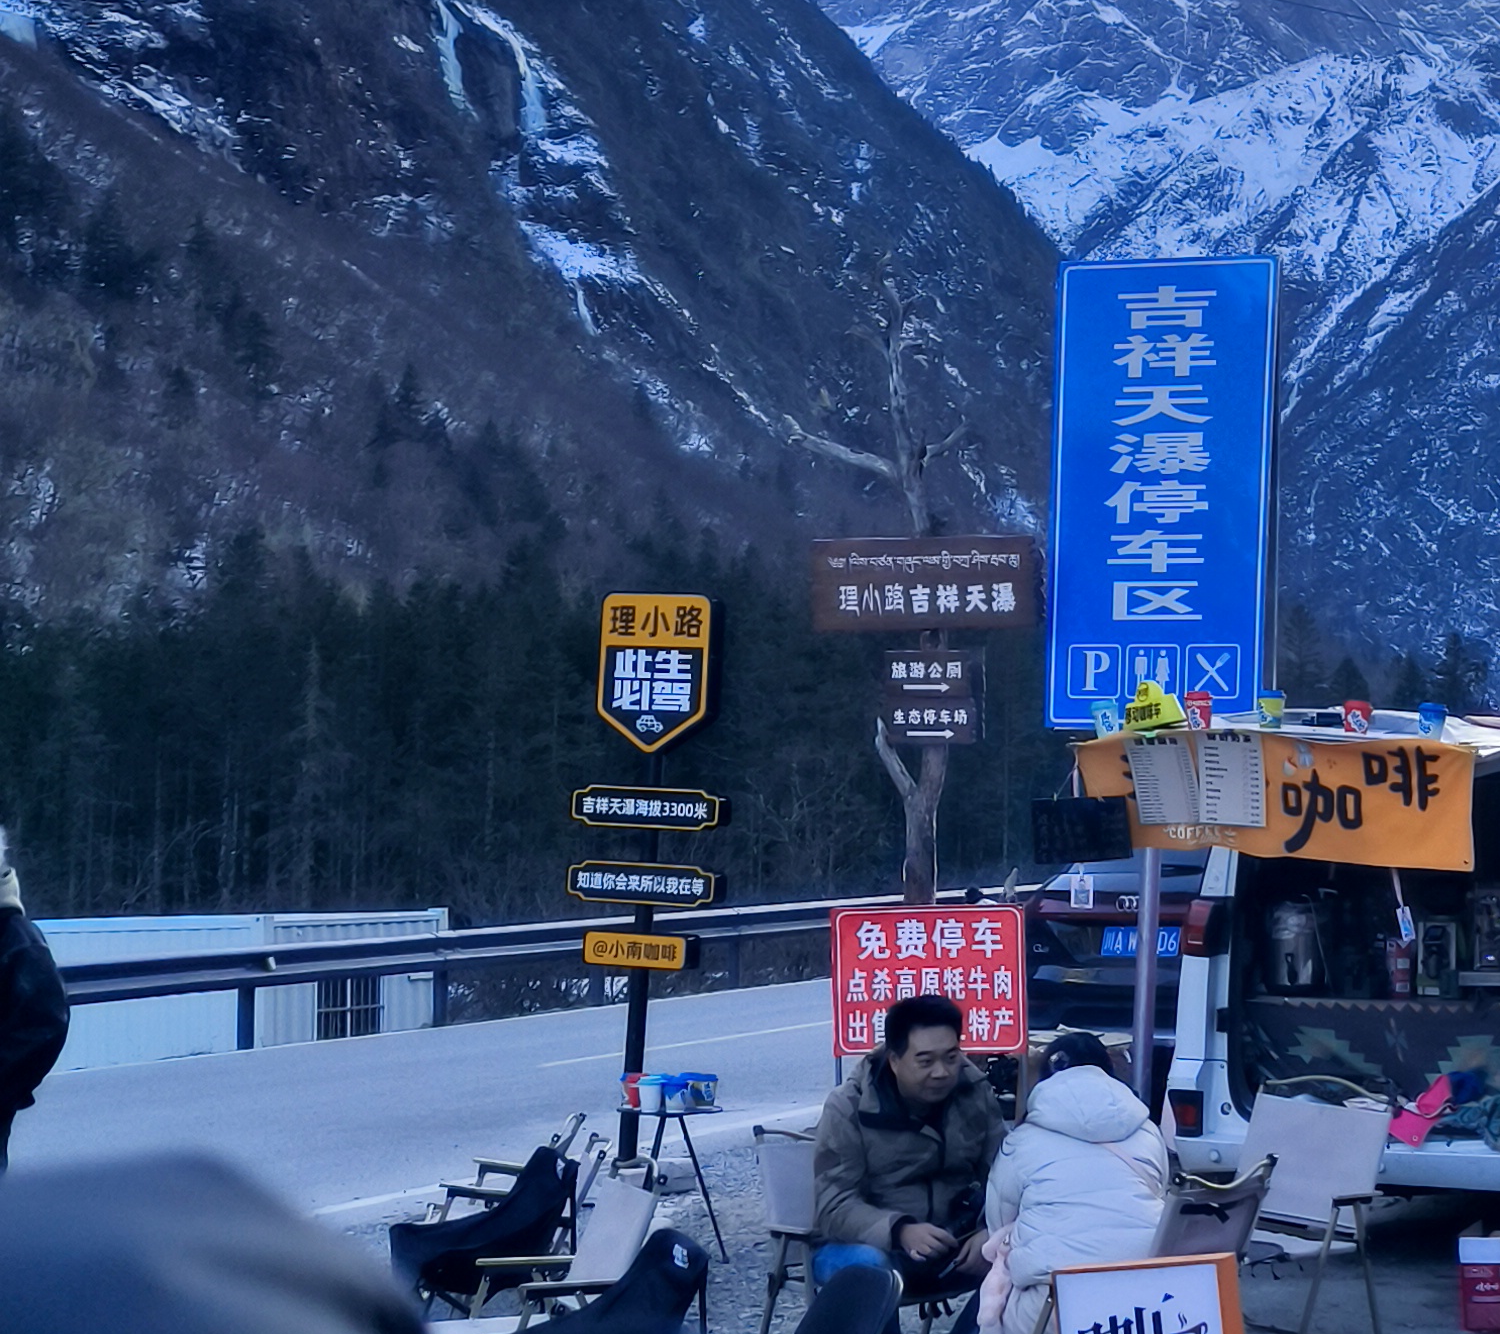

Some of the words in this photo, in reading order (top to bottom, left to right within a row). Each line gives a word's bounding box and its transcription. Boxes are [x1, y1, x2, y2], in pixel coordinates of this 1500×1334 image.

[1105, 286, 1217, 620] 吉祥天瀑停车区
[839, 582, 1016, 617] 理小路吉祥天瀑
[608, 605, 703, 638] 理小路
[614, 649, 692, 679] 此生
[891, 661, 962, 679] 旅游公厕
[612, 680, 692, 712] 必驾
[893, 708, 968, 725] 生态停车场
[582, 796, 708, 820] 吉祥天瀑海拔3300米
[1281, 745, 1441, 854] 咖啡
[576, 870, 705, 897] 知道你会来所以我在等
[592, 939, 678, 962] @小南咖啡
[855, 918, 1004, 960] 免费停车
[846, 966, 1013, 1002] 点杀高原牦牛肉
